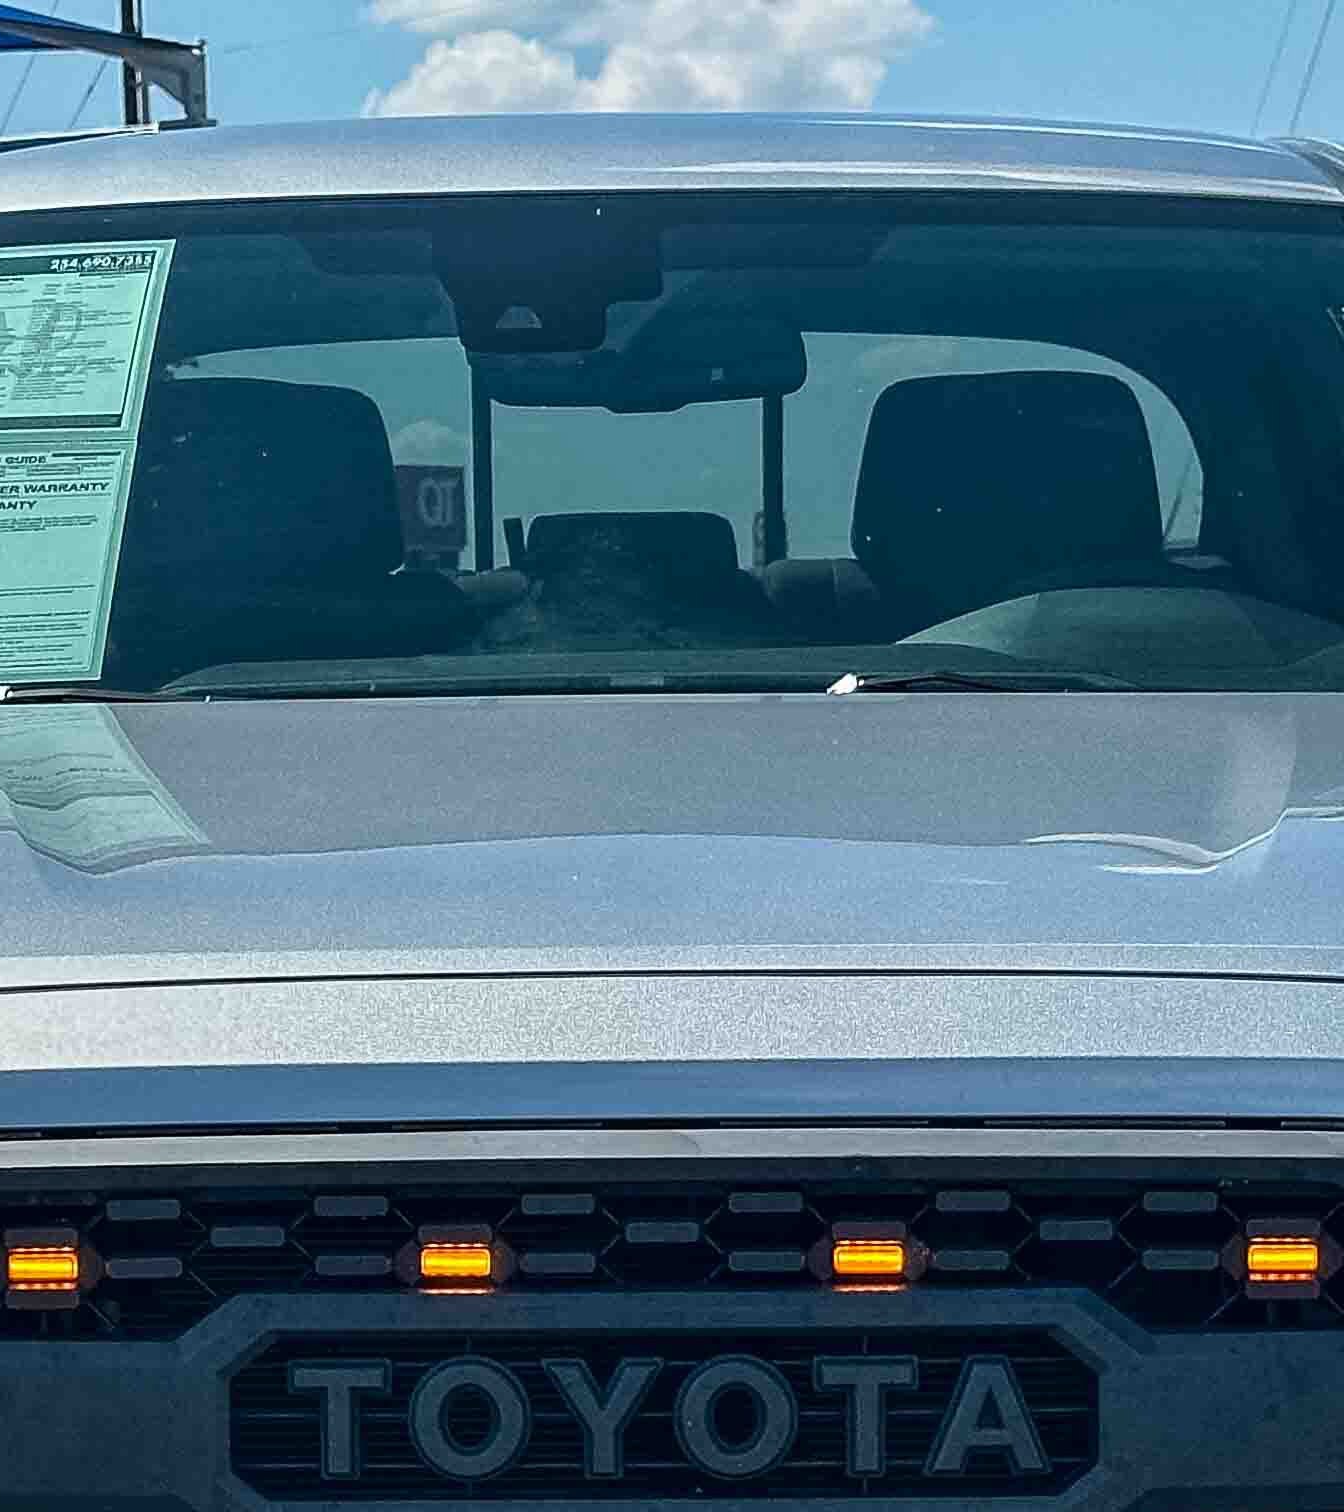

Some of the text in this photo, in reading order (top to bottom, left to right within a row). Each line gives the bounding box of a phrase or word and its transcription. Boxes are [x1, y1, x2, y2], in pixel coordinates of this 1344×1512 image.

[5, 455, 47, 465] GUIDE
[23, 481, 110, 494] WARRANTY
[288, 1354, 1053, 1480] TOYOTA
